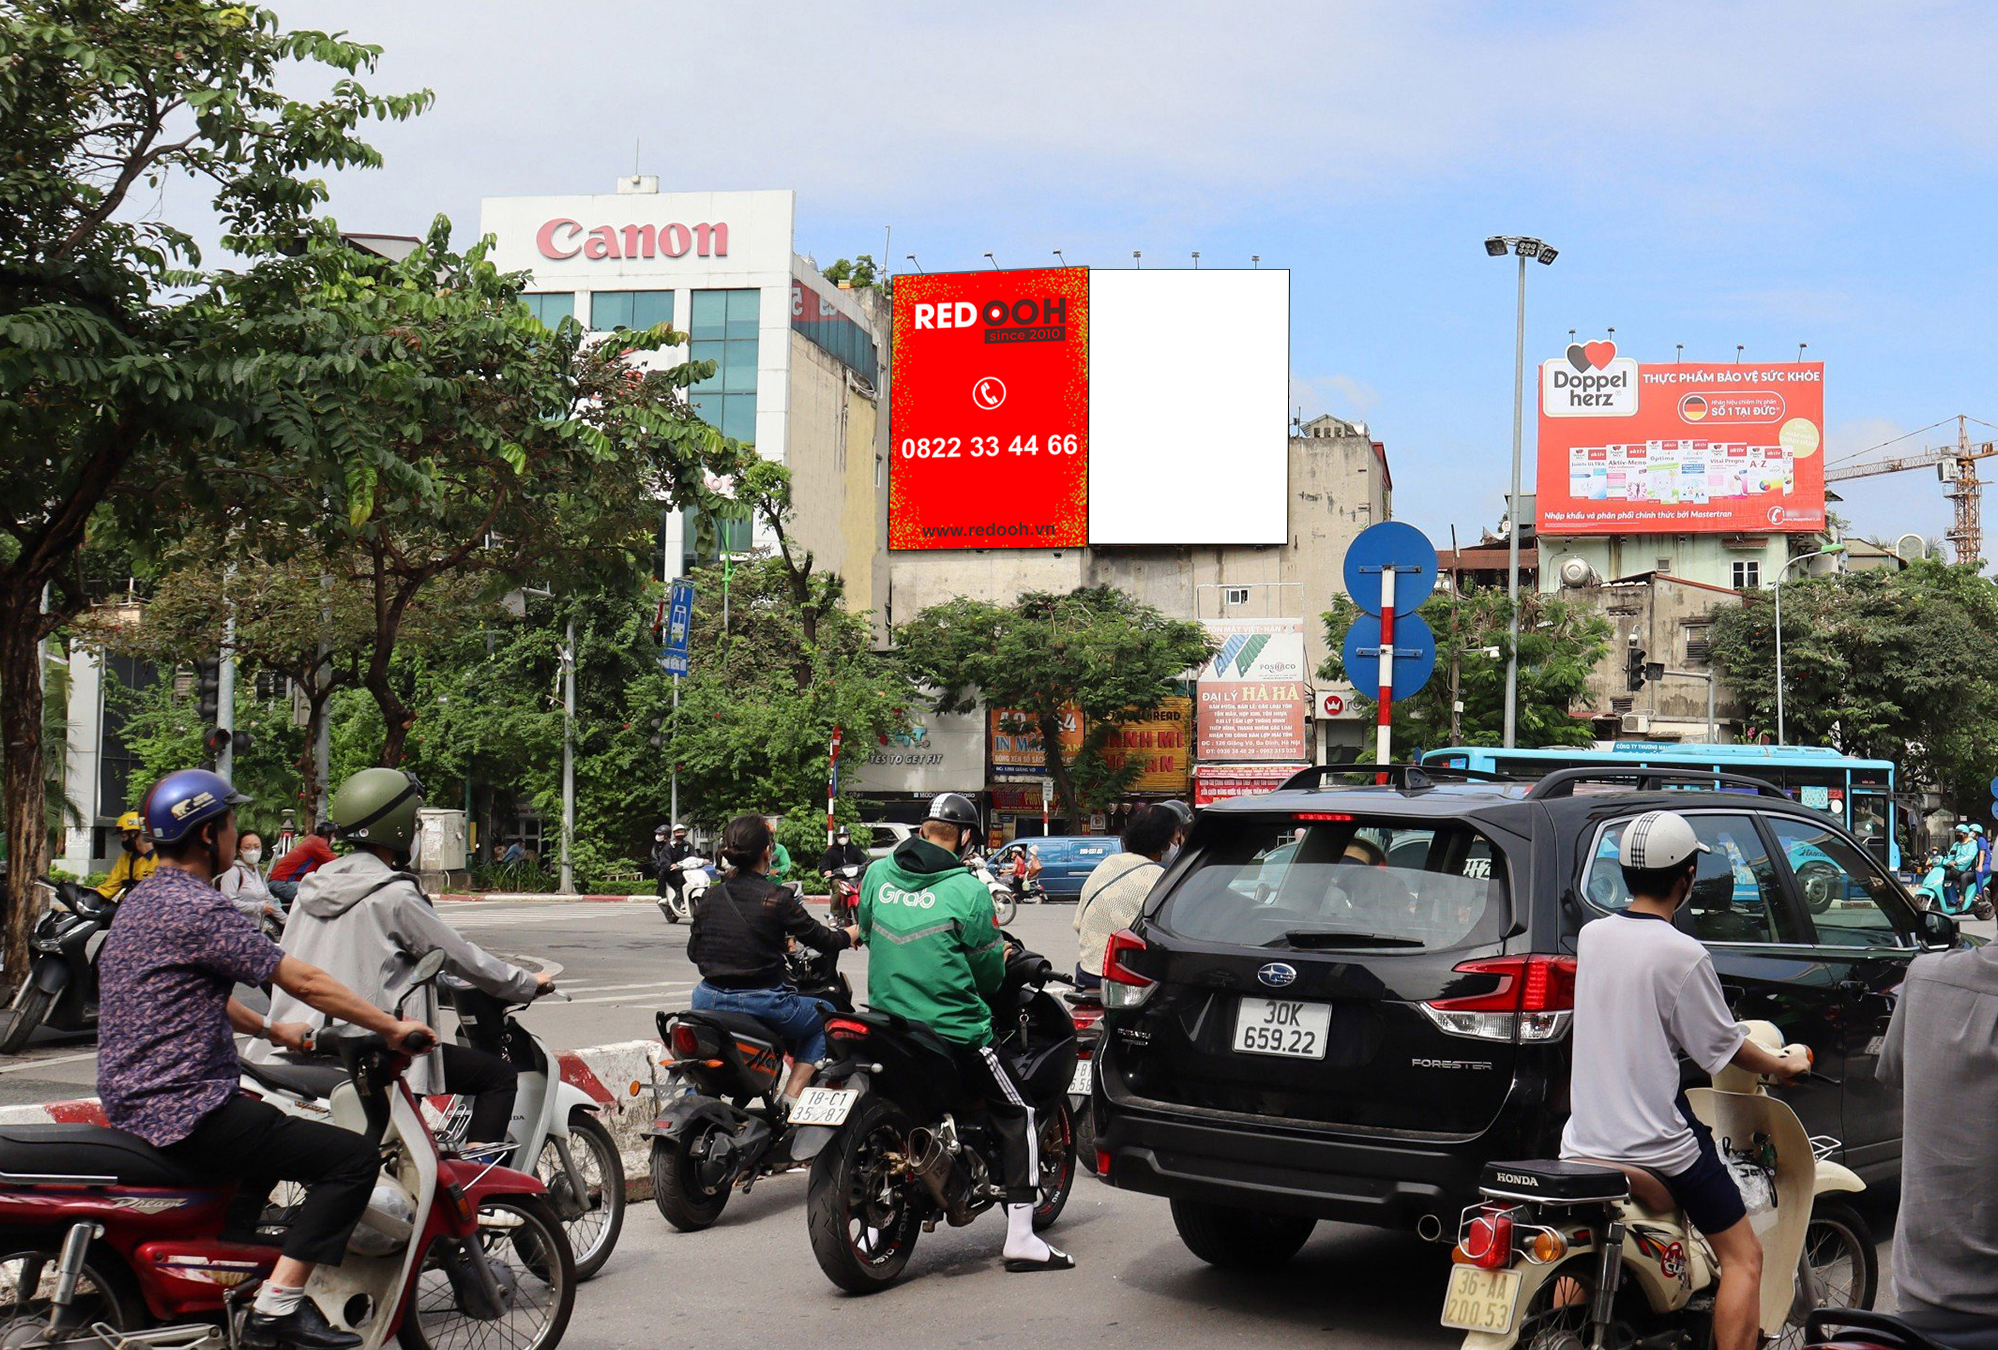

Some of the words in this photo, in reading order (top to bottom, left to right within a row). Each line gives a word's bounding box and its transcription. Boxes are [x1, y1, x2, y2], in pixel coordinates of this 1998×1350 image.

[536, 218, 728, 260] Canon
[914, 302, 978, 330] RED
[982, 298, 1066, 326] OOH
[989, 328, 1026, 342] since
[1029, 327, 1060, 340] 2010
[1554, 370, 1626, 392] Doppel
[1643, 373, 1676, 385] THỰC
[1680, 370, 1714, 382] PHẨM
[1718, 370, 1742, 382] BẢO
[1744, 370, 1758, 383] VỆ
[1761, 370, 1784, 382] SỨC
[1788, 370, 1820, 382] KHỎE
[1570, 390, 1614, 406] herz
[1712, 405, 1726, 416] SỐ
[1728, 407, 1732, 415] 1
[1734, 407, 1750, 417] TẠI
[901, 437, 962, 459] 0822
[970, 436, 1000, 458] 33
[1008, 435, 1039, 456] 44
[1047, 434, 1078, 456] 66
[1544, 512, 1565, 520] Nhập
[1566, 510, 1585, 520] khẩu
[1597, 512, 1616, 520] phân
[1617, 511, 1634, 520] phối
[1676, 510, 1690, 518] bởi
[922, 522, 1056, 538] www.redooh.vn
[1202, 692, 1221, 703] ĐẠI
[1224, 690, 1238, 700] LÝ
[1242, 684, 1270, 700] HÀ
[1272, 683, 1300, 700] HÀ
[995, 735, 1012, 751] IN
[890, 755, 903, 764] TO
[905, 754, 925, 764] GET
[926, 754, 943, 764] FIT
[878, 882, 936, 909] Grab
[1264, 1001, 1304, 1026] 30K
[1244, 1026, 1316, 1054] 659.22
[1412, 1058, 1492, 1070] FORESTER
[808, 1092, 848, 1106] 18-C1
[1496, 1172, 1539, 1187] HONDA
[111, 1197, 188, 1209] Dream
[1458, 1270, 1508, 1300] 36-AA
[1447, 1298, 1508, 1328] 200.53
